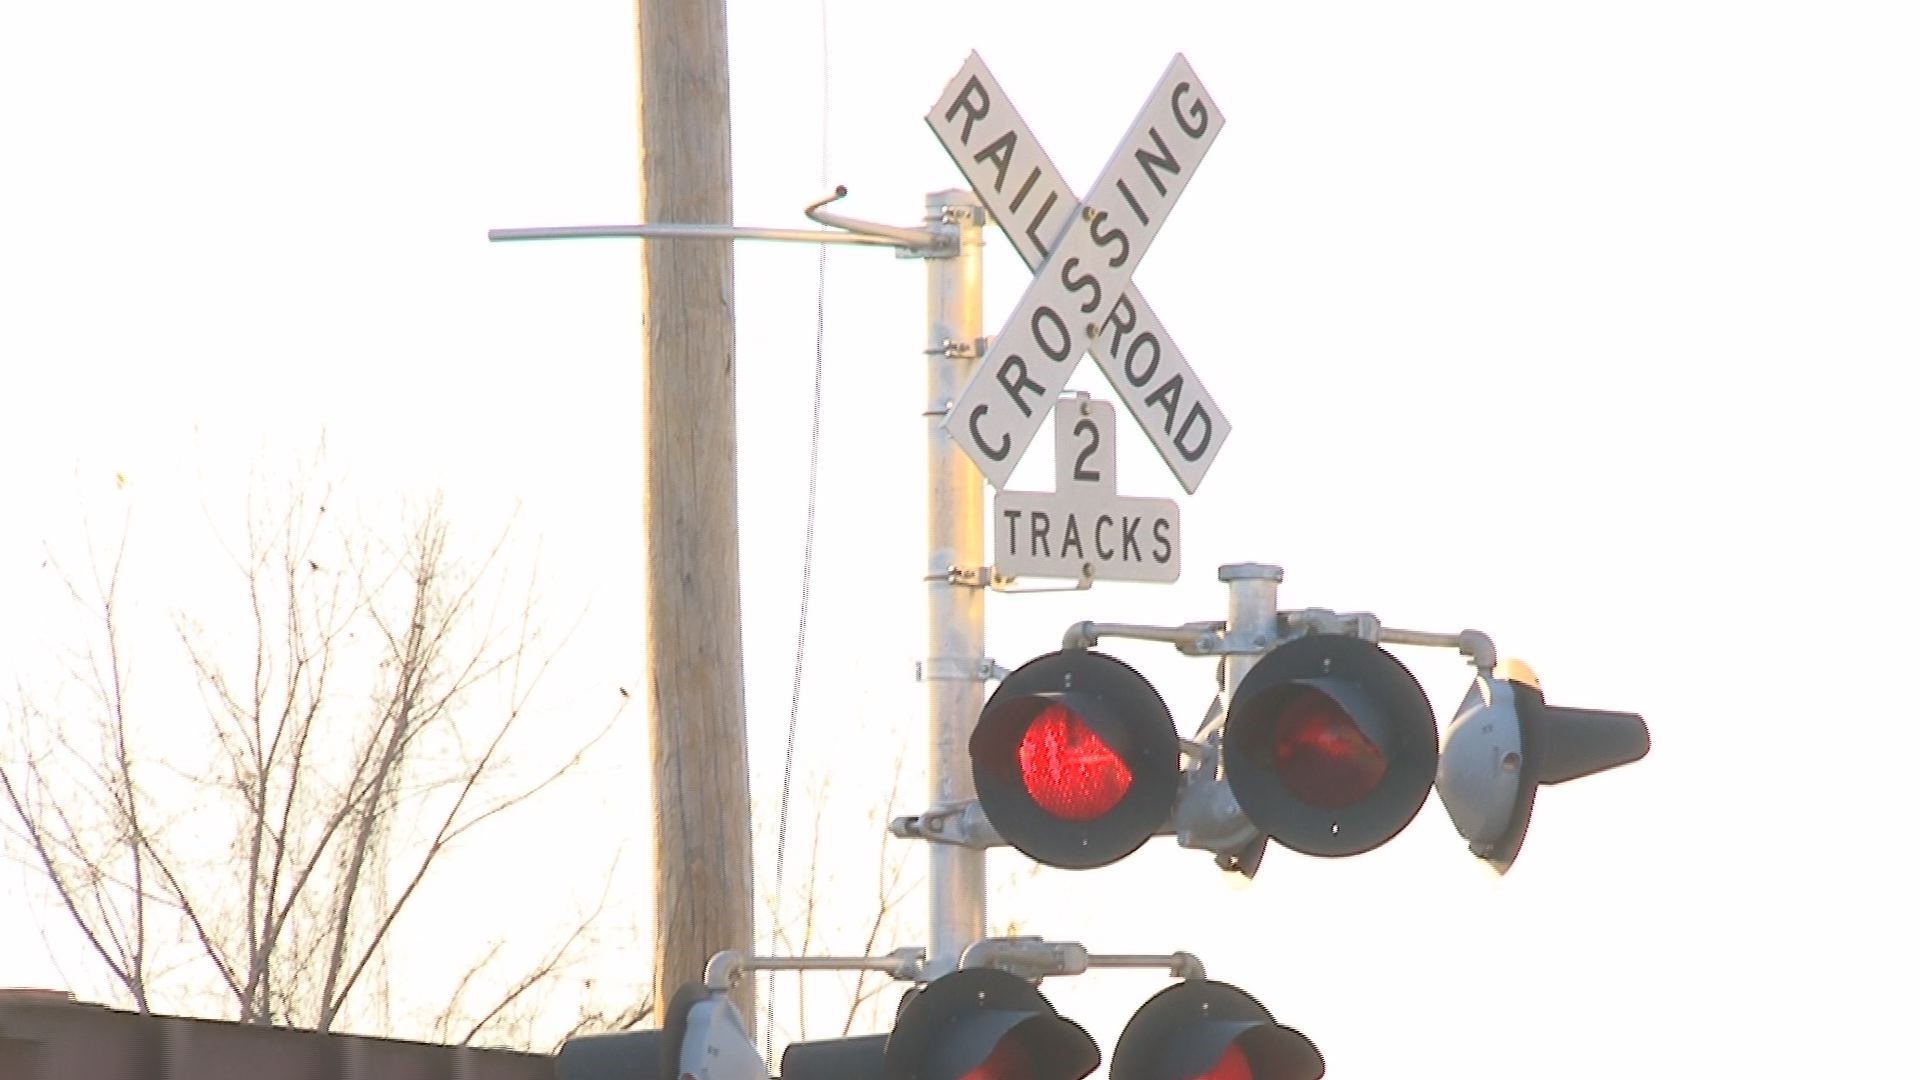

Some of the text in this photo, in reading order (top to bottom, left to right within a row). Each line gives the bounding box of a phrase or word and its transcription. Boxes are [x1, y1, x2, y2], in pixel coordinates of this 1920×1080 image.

[945, 74, 1212, 463] RAIL ROAD
[969, 82, 1209, 462] CROSSING
[1003, 510, 1172, 564] TRACKS
[1073, 418, 1100, 482] 2
